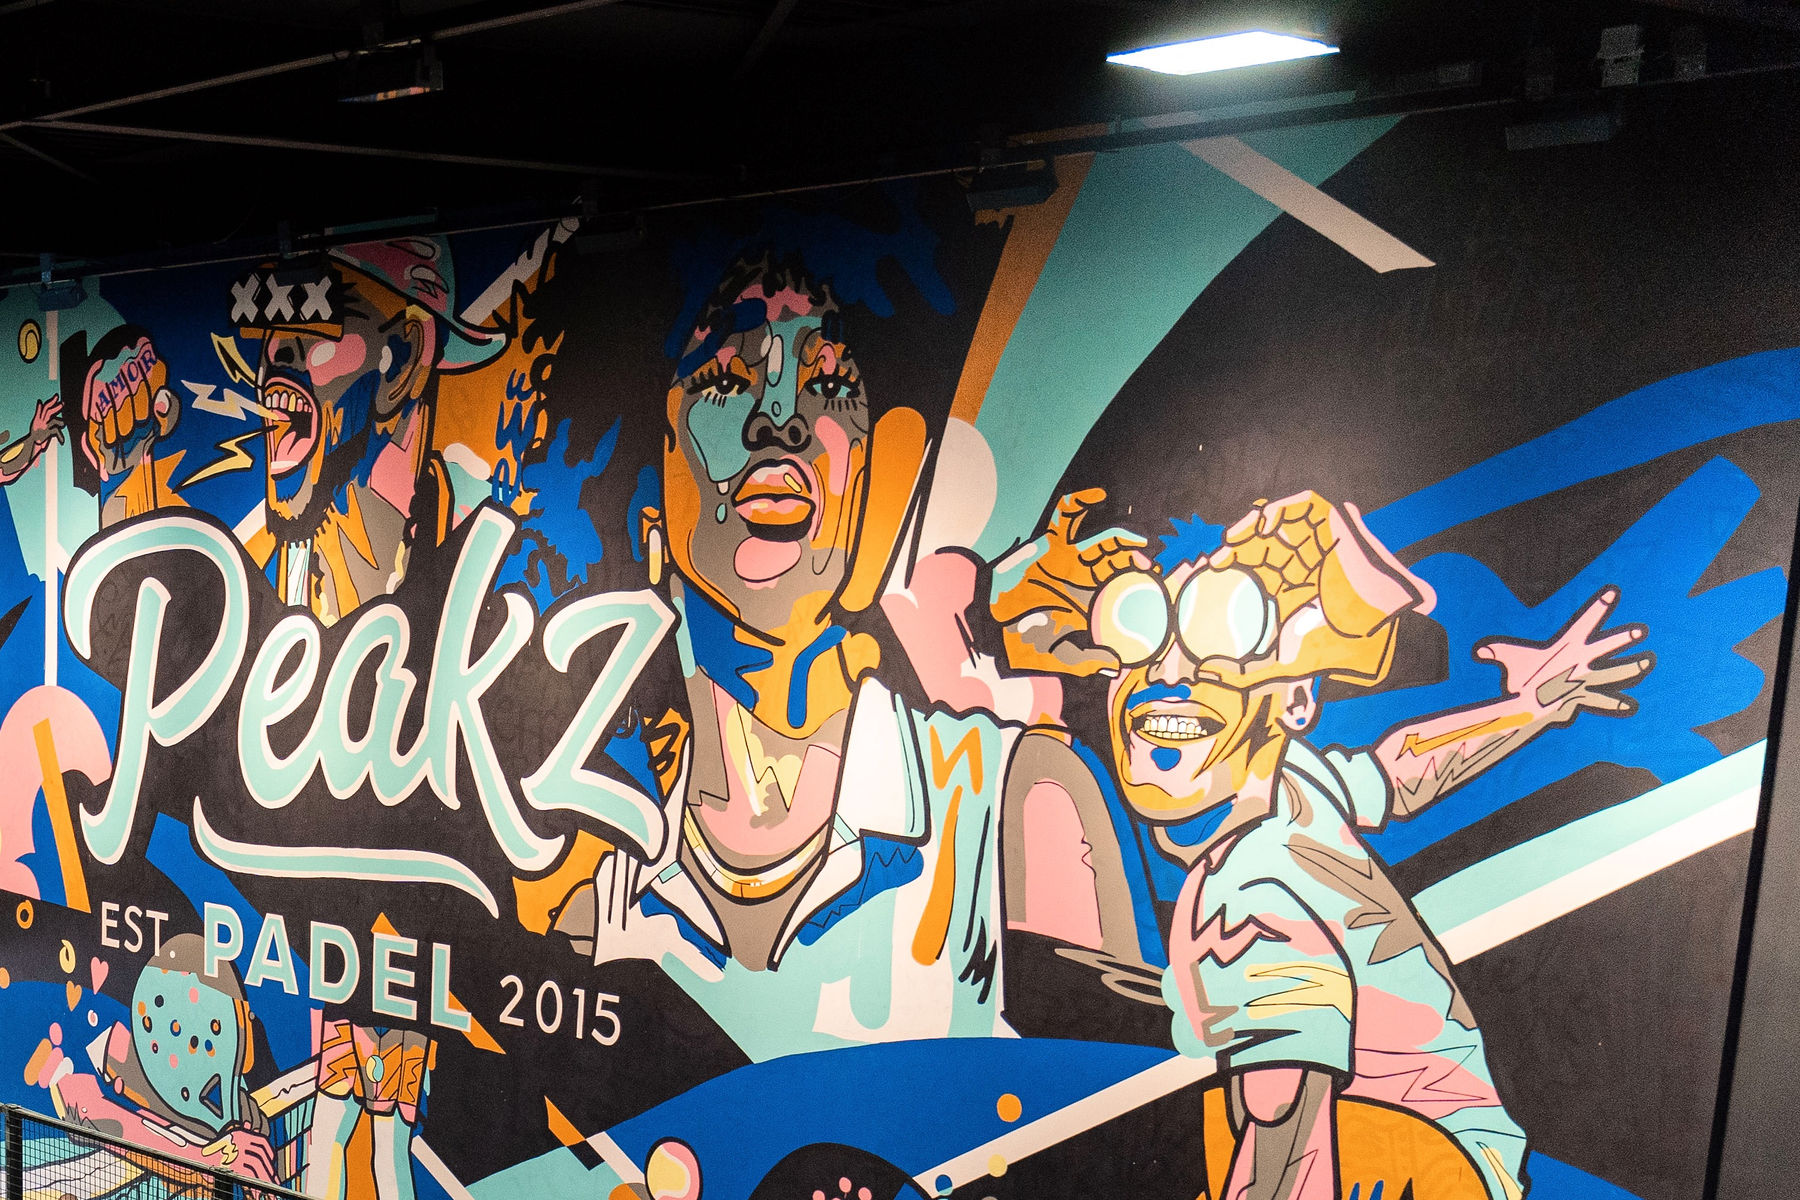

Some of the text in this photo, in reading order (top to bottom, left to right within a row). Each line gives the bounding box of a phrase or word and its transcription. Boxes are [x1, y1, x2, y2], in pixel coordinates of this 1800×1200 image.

[98, 350, 157, 412] AMOR
[67, 508, 674, 869] Peakz
[203, 902, 472, 1032] PADEL
[498, 973, 622, 1046] 2015
